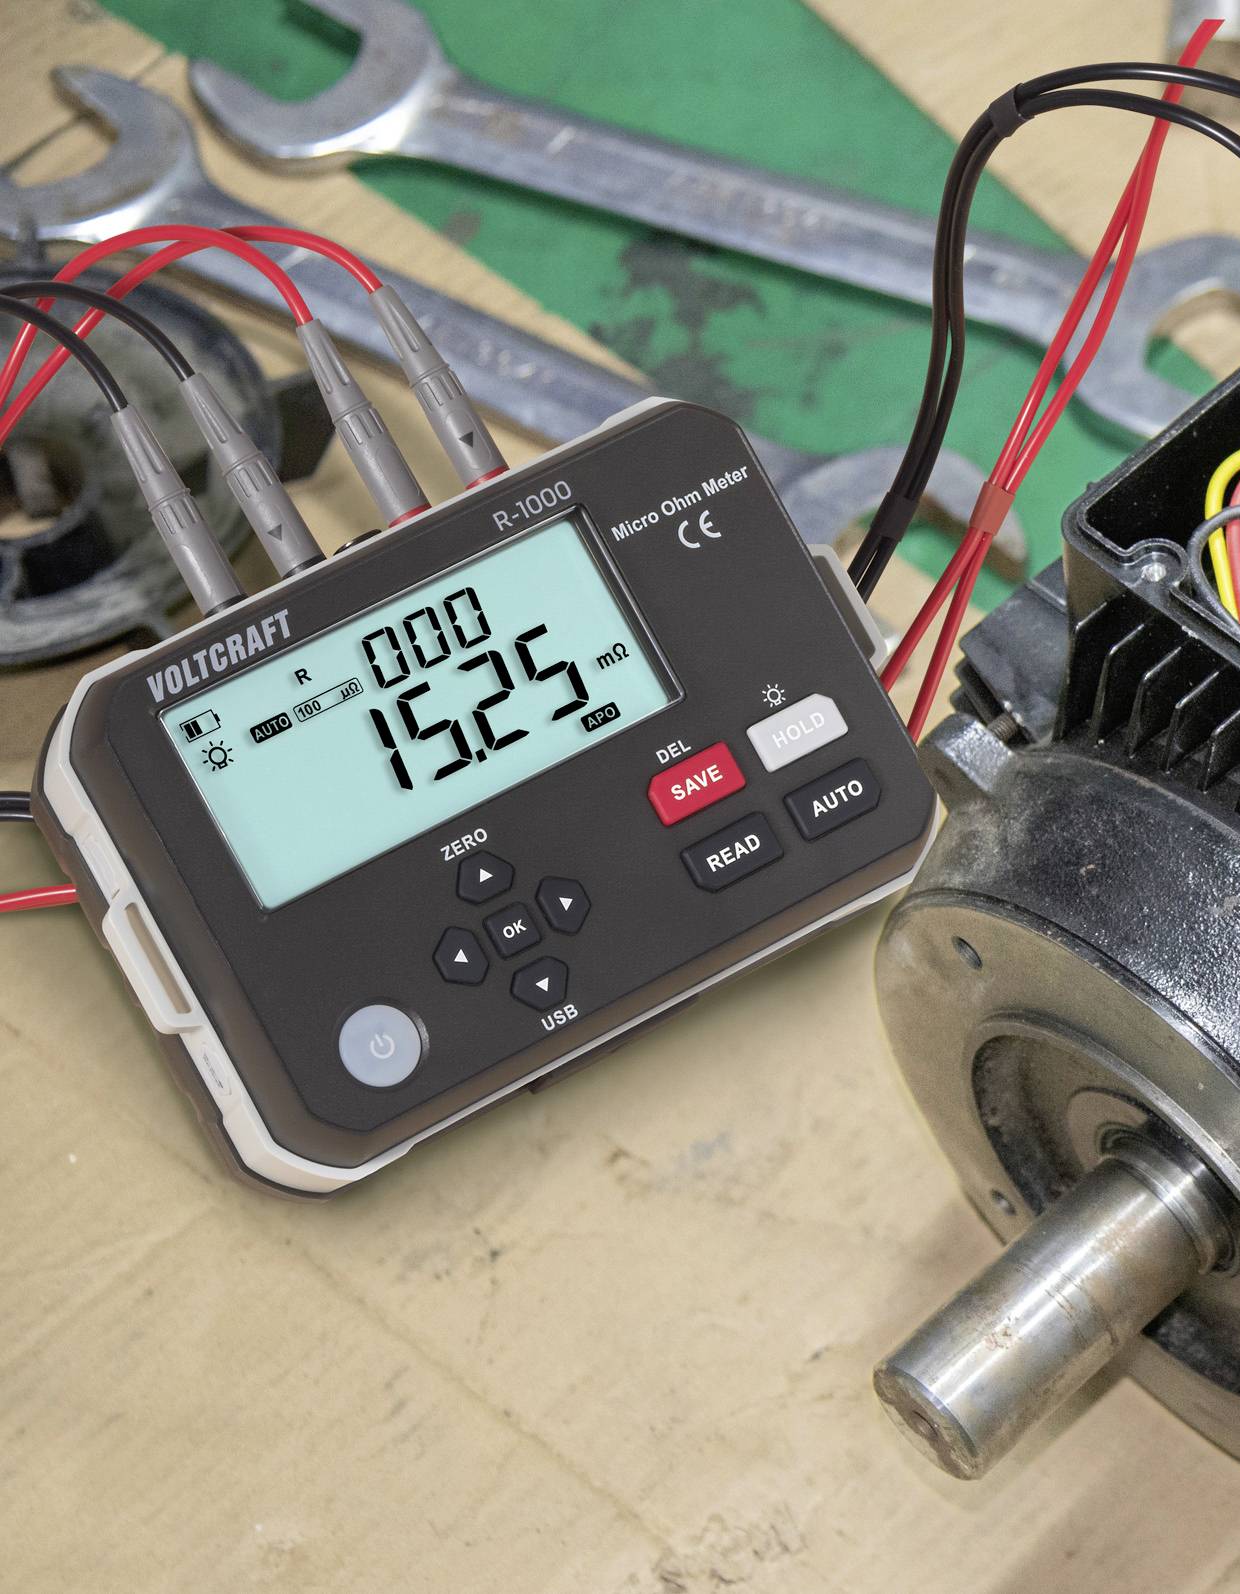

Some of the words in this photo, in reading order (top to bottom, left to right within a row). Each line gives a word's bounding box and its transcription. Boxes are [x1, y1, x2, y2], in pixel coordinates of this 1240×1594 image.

[492, 480, 572, 532] R-1000
[611, 511, 660, 542] Micro
[660, 489, 703, 517] Ohm
[701, 465, 749, 498] Meter
[677, 509, 722, 549] CE
[146, 608, 293, 703] VOLTCRAFT
[361, 586, 492, 690] 000
[293, 667, 313, 686] R
[252, 714, 291, 742] AUTO
[297, 699, 322, 720] 100
[368, 622, 590, 791] 15.25
[596, 641, 630, 670] mΩ
[585, 705, 617, 729] APO
[771, 711, 825, 749] HOLD
[655, 739, 692, 765] DEL
[670, 763, 724, 801] SAVE
[811, 779, 864, 818] AUTO
[440, 827, 488, 862] ZERO
[706, 833, 761, 873] READ
[502, 919, 528, 940] OK
[541, 1003, 579, 1032] USB
